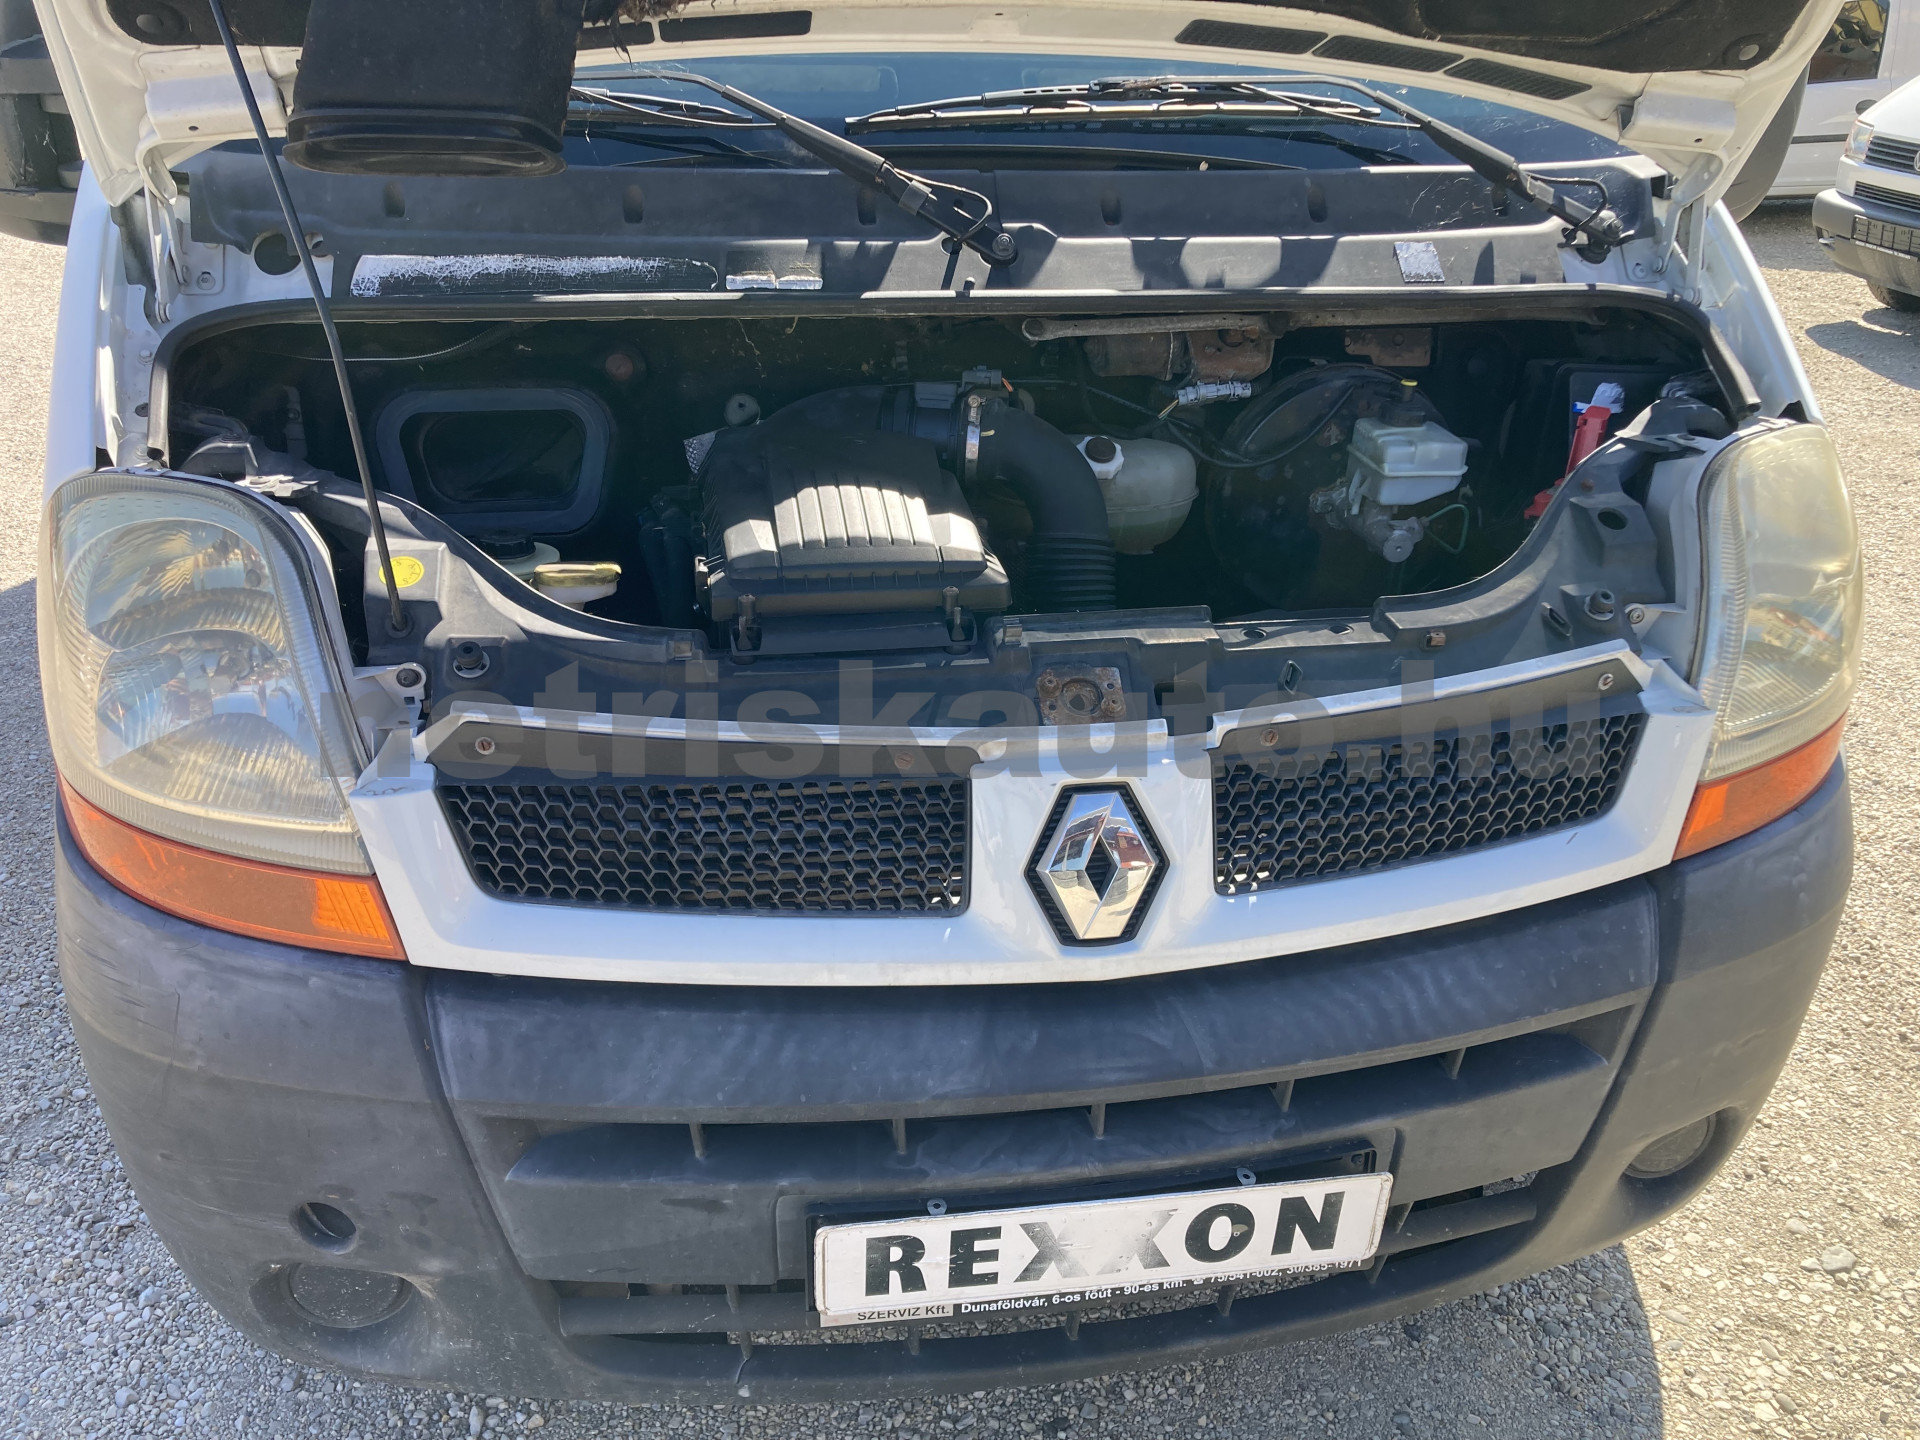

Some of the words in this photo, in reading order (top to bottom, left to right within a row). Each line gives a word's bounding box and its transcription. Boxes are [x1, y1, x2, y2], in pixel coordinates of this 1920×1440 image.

[864, 1191, 1346, 1297] REXXON
[857, 1307, 921, 1321] SZERVIZ
[925, 1304, 950, 1316] Kft.
[961, 1296, 1048, 1314] Dunaföldvár,
[1052, 1294, 1081, 1305] 6-os
[1123, 1282, 1160, 1295] 90-es
[1163, 1279, 1187, 1290] km.
